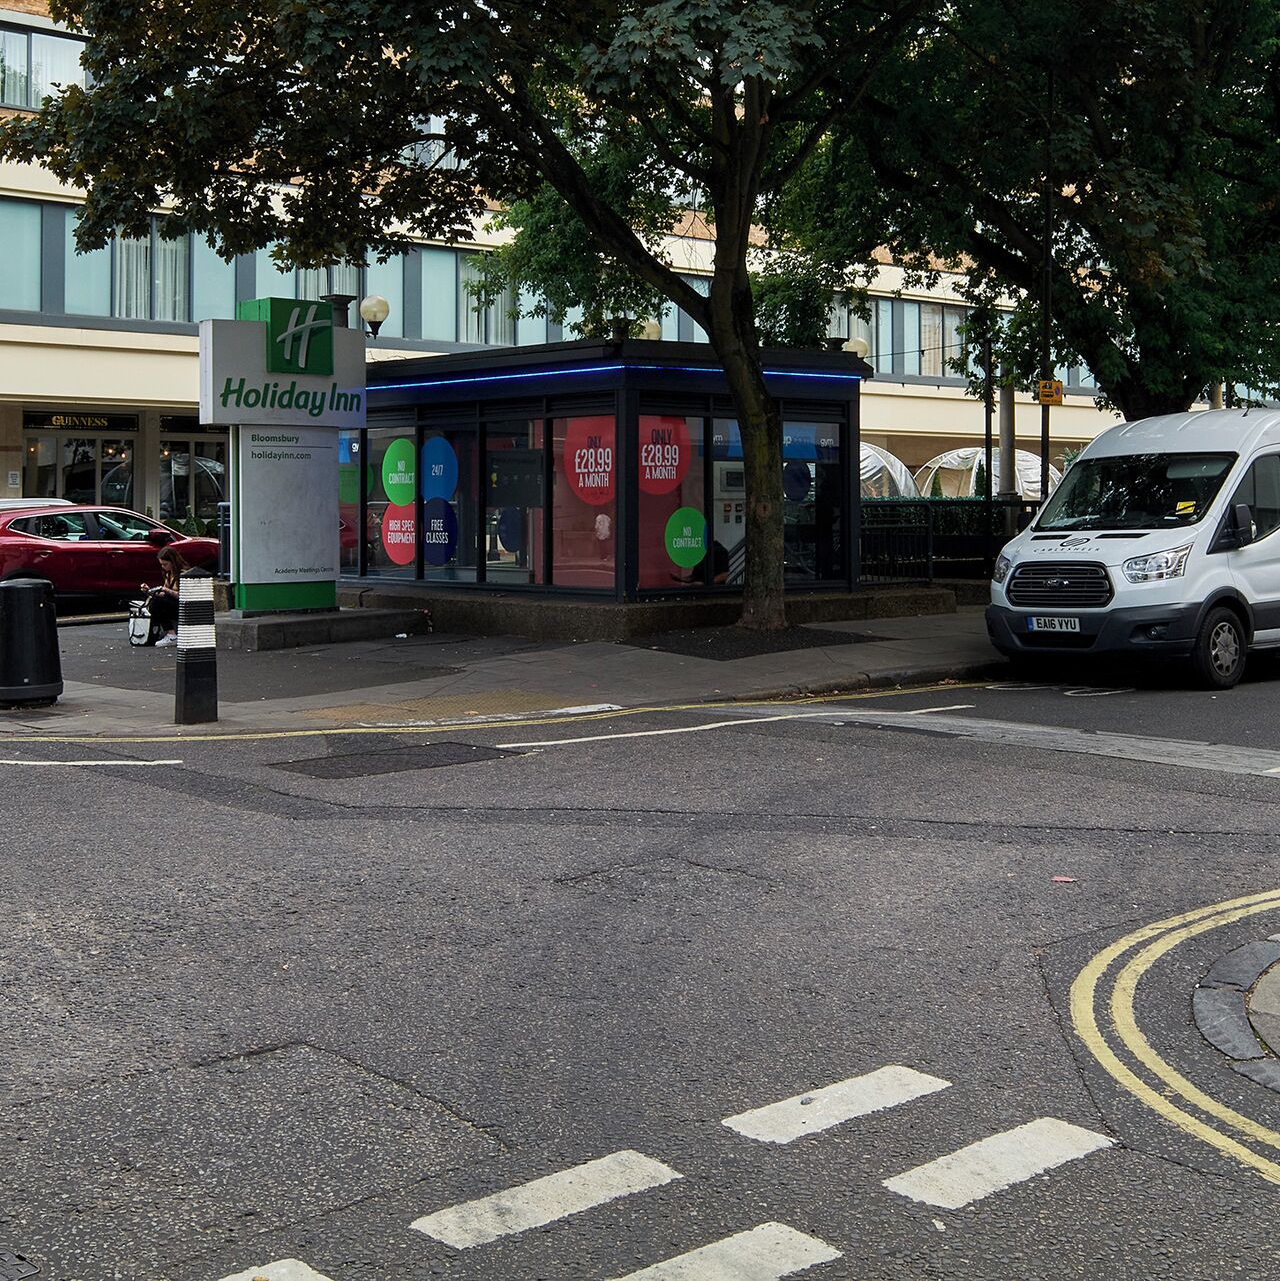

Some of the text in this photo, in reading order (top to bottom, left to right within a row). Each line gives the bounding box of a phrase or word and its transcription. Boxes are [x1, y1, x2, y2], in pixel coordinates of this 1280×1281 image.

[220, 377, 361, 417] Holiday Inn
[52, 415, 108, 427] GUINNESS
[252, 434, 300, 444] Bloomsbury
[652, 429, 672, 445] ONLY
[251, 451, 312, 460] holidayinn.com
[575, 448, 612, 473] £28.99
[641, 444, 679, 466] £28.99
[397, 460, 406, 472] NO
[431, 464, 444, 476] 24/7
[388, 473, 415, 484] CONTRACT
[645, 467, 677, 479] A MONTH
[578, 473, 609, 488] A MONTH
[388, 520, 415, 531] HIGH SPEC
[430, 519, 444, 531] FREE
[682, 527, 692, 536] NO
[387, 532, 415, 544] EQUIPMENT
[425, 532, 449, 544] CLASSES
[672, 538, 702, 548] CONTRACT
[1037, 618, 1077, 630] EA16 VYU
